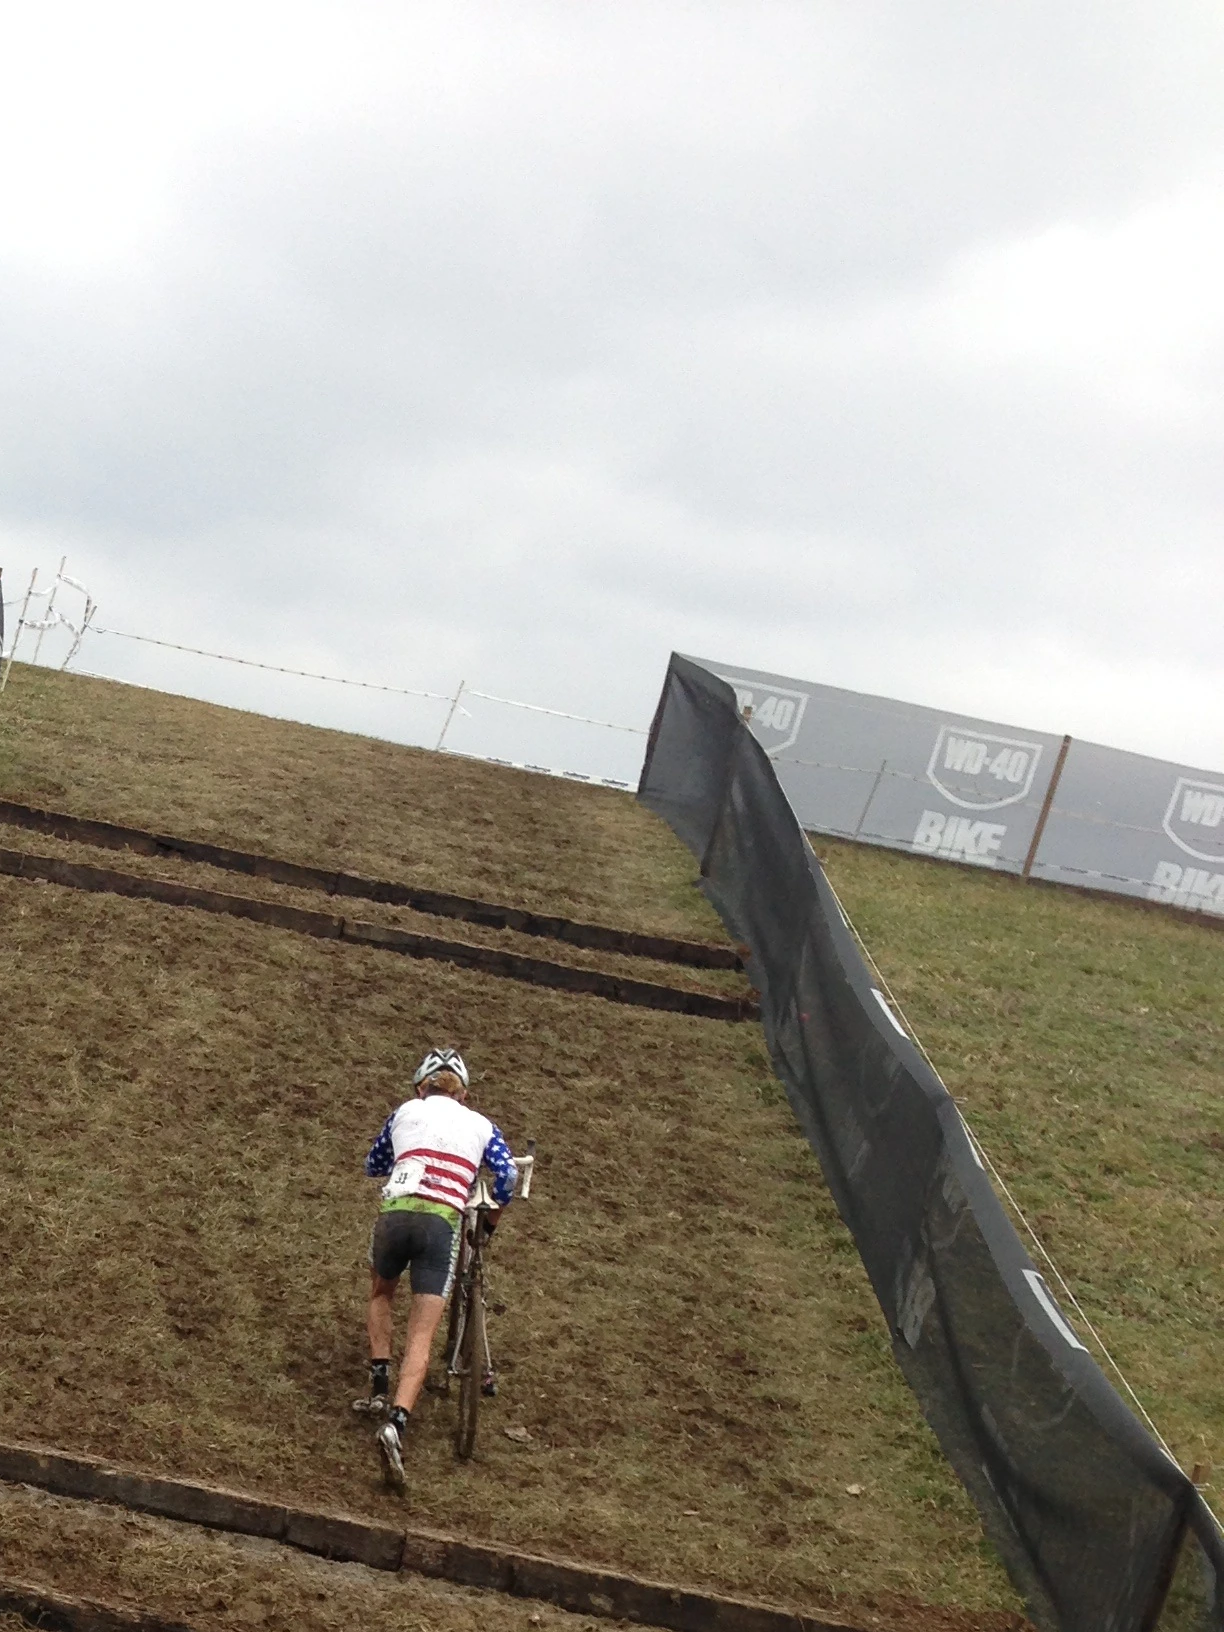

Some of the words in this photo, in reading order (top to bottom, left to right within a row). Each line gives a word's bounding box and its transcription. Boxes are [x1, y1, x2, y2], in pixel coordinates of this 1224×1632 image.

[735, 688, 796, 731] D-40
[943, 736, 1030, 783] WD-40
[911, 809, 1008, 866] BIKE
